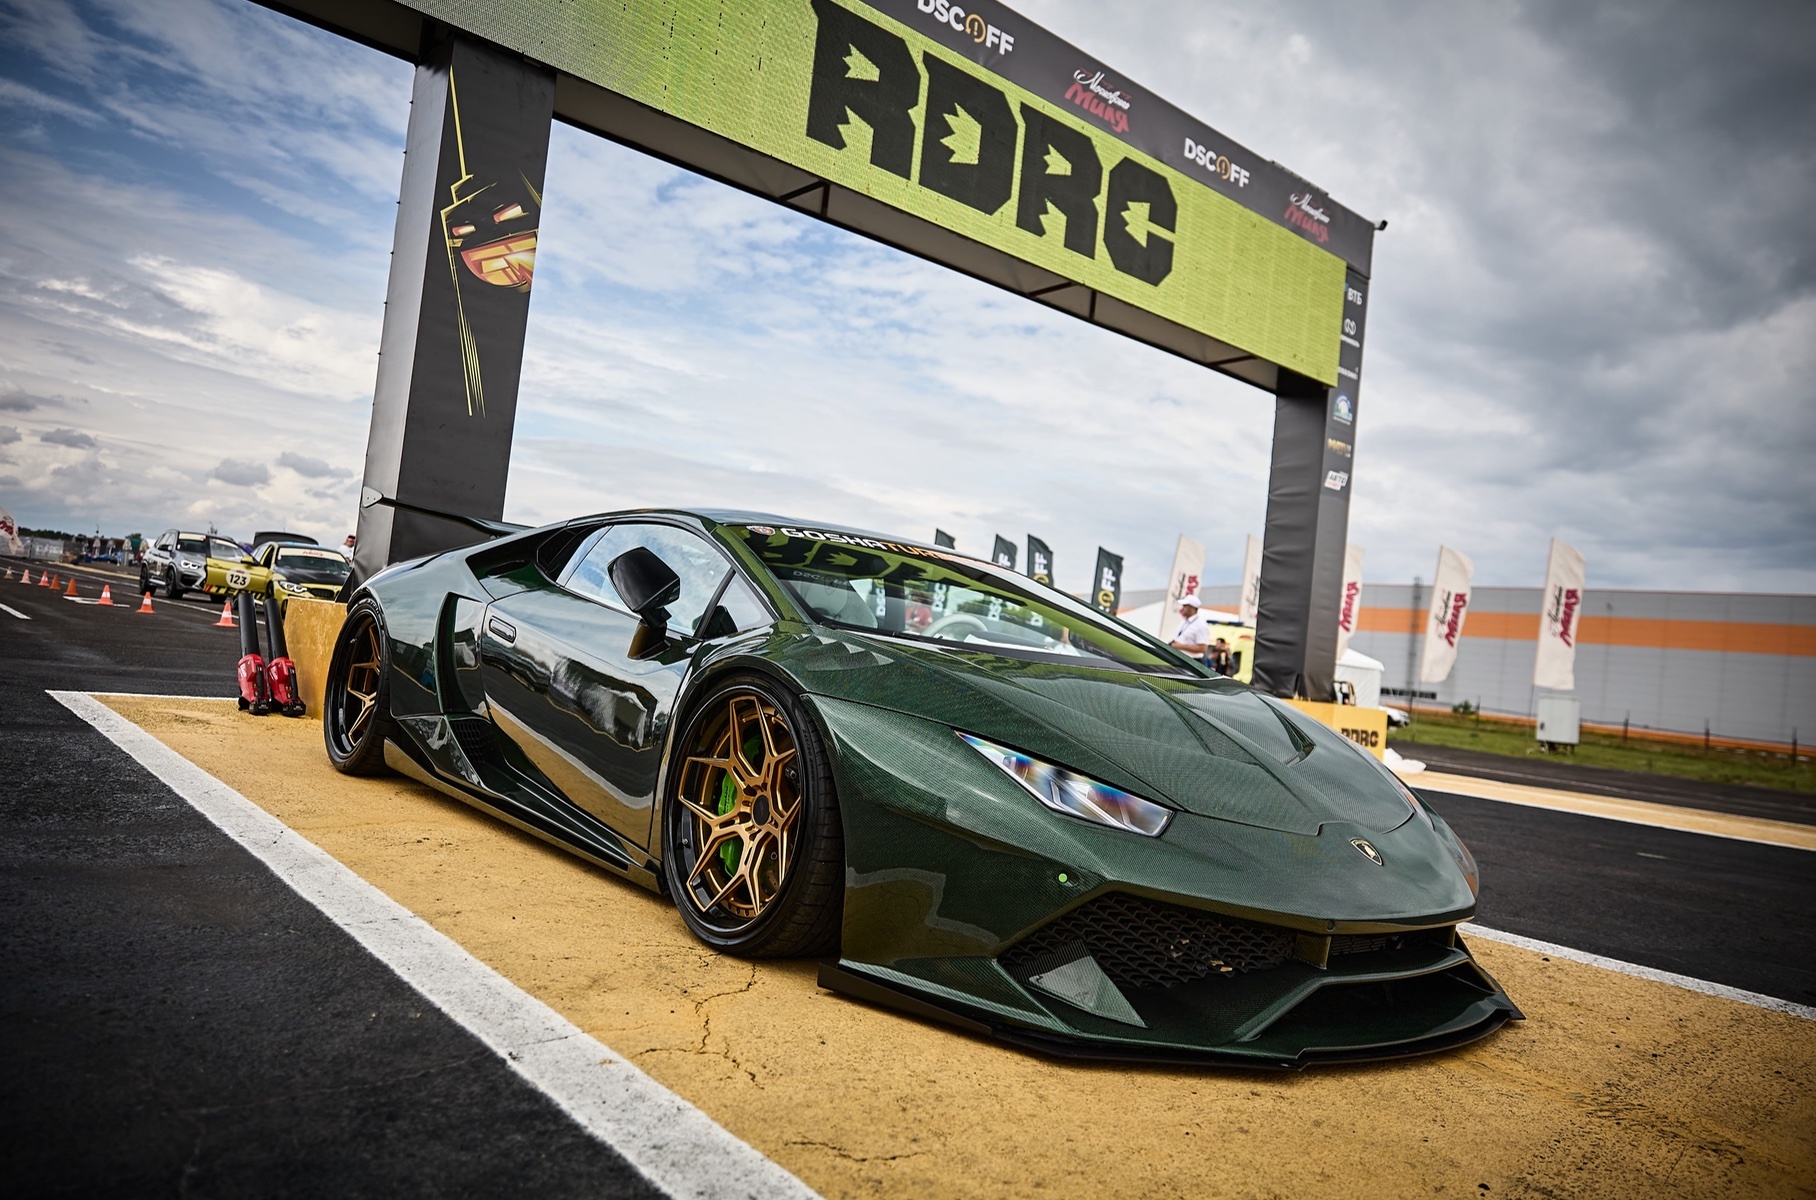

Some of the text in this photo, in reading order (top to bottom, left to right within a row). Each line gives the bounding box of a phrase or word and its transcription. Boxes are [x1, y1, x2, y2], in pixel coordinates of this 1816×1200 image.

[806, 0, 1178, 287] RDRC
[1184, 137, 1250, 188] DSCOFF
[229, 574, 247, 586] 123
